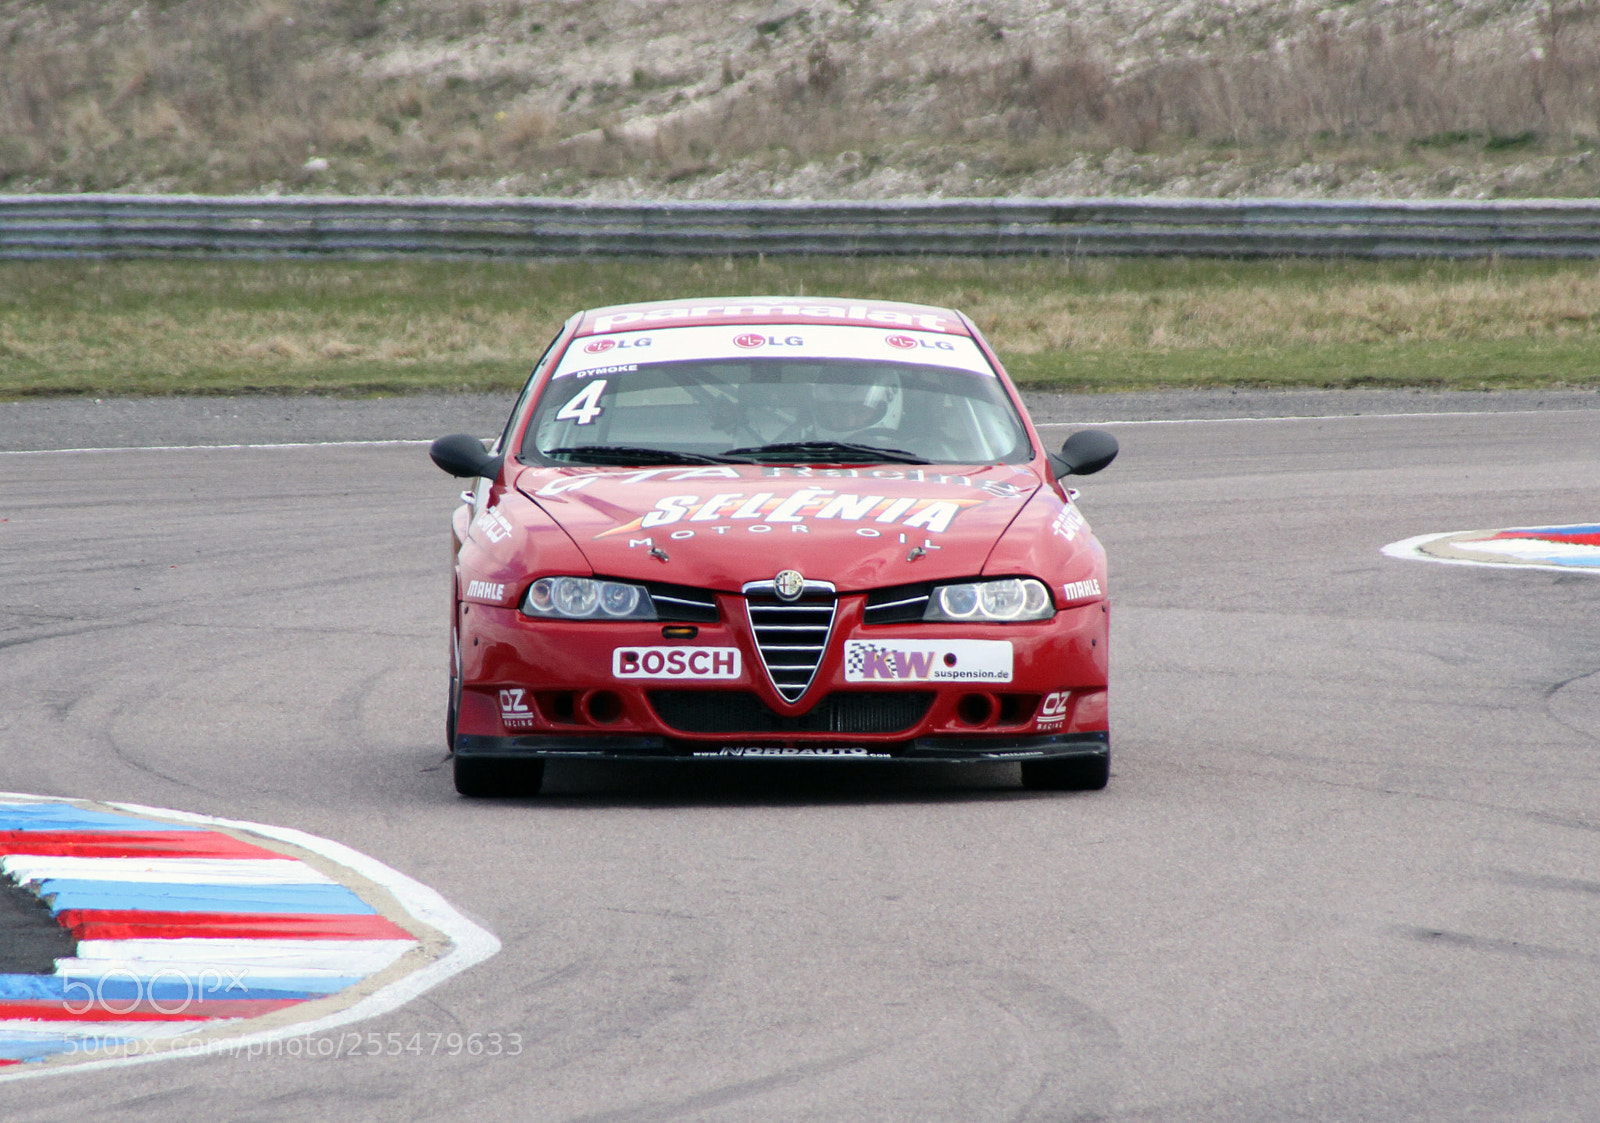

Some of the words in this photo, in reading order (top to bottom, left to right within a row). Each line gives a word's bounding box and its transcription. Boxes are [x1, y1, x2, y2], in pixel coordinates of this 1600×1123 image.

[592, 304, 947, 333] parmalat
[617, 337, 652, 349] LG
[768, 336, 804, 346] LG
[919, 339, 955, 351] LG
[576, 364, 638, 378] DYMOKE
[556, 379, 607, 425] 4
[629, 524, 810, 548] MOTOR
[856, 528, 942, 549] OIL
[466, 580, 505, 601] MAHLE
[1063, 578, 1102, 601] MAHLE
[619, 650, 735, 675] BOSCH
[863, 651, 935, 679] KW
[934, 669, 1010, 679] suspension.de
[499, 688, 528, 712] OZ
[1042, 691, 1072, 715] OZ
